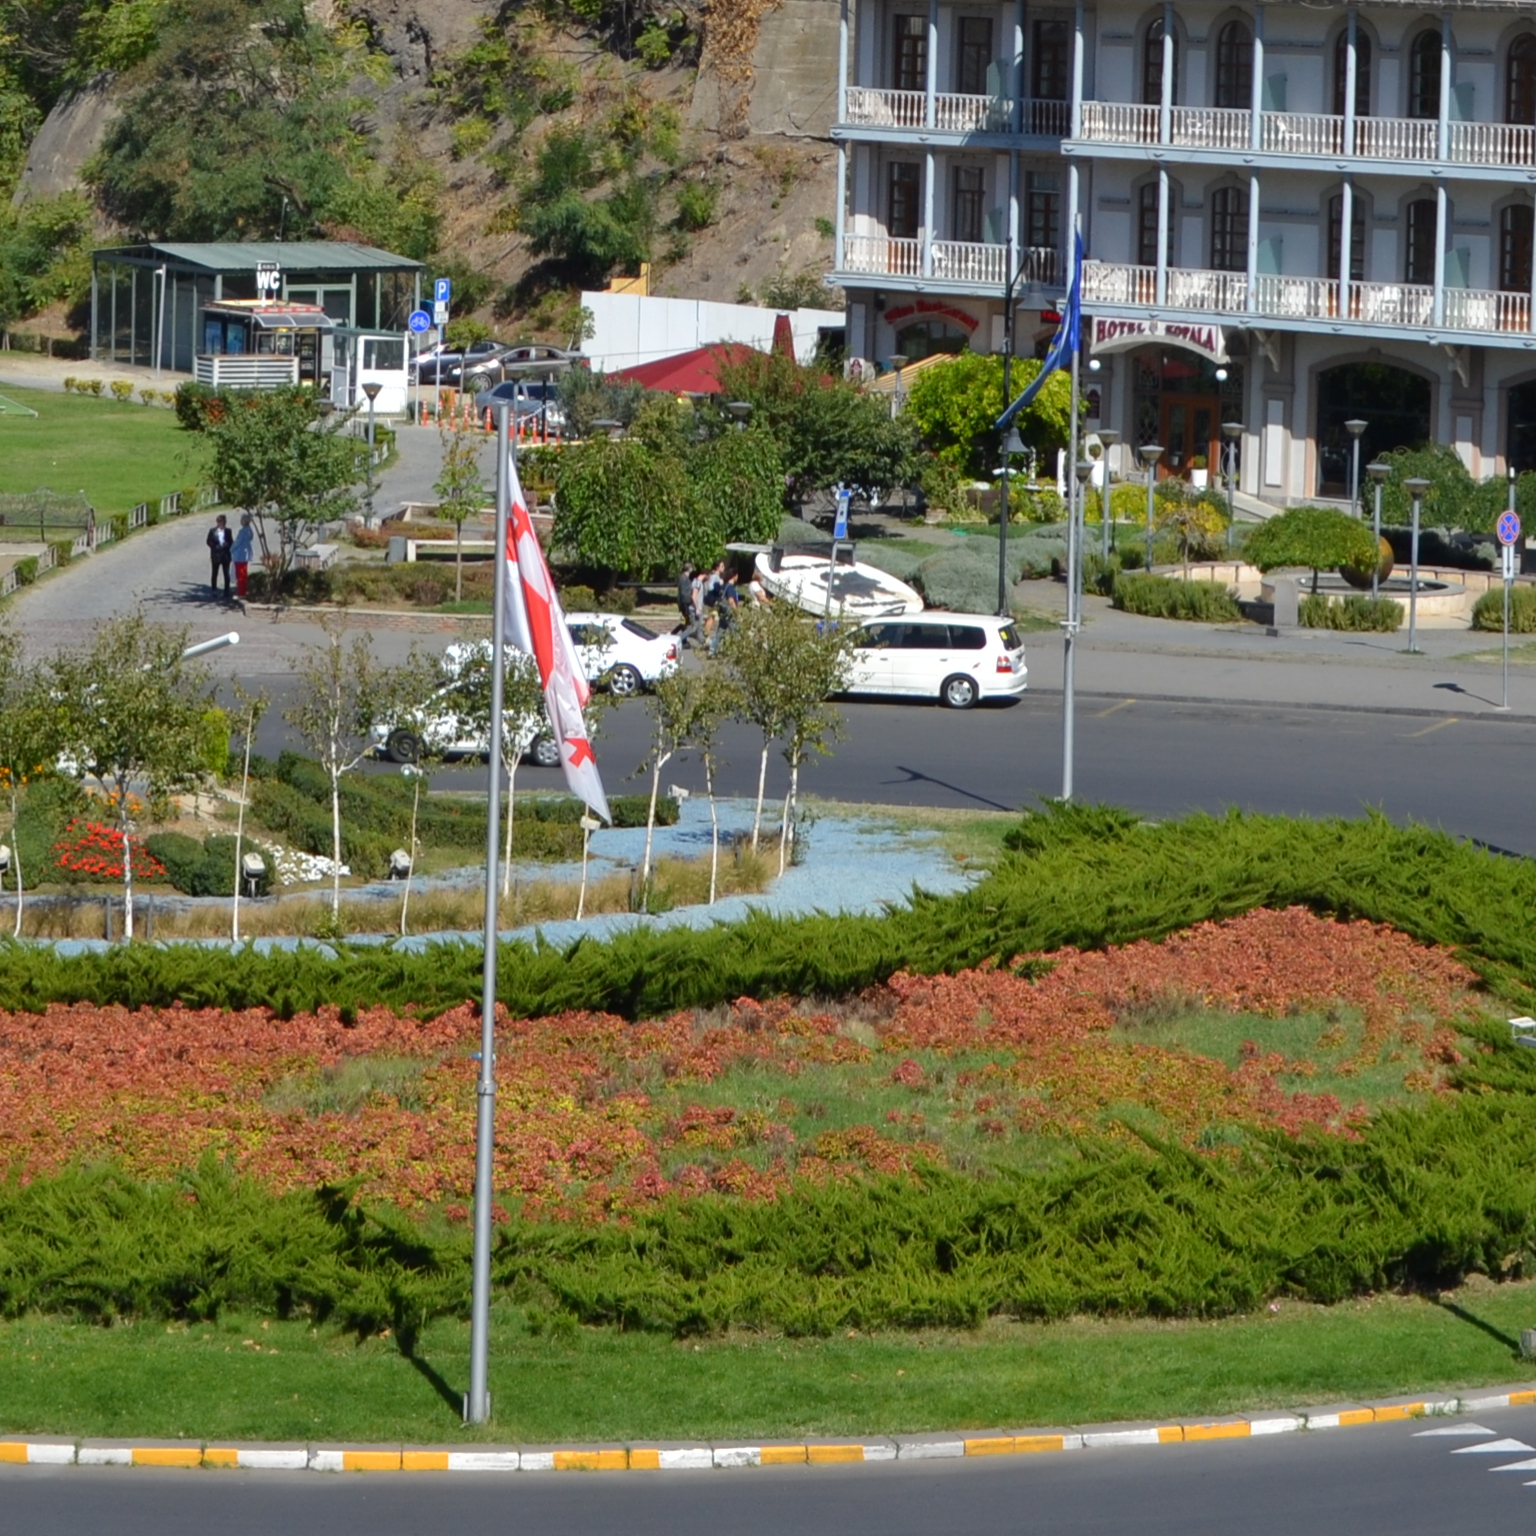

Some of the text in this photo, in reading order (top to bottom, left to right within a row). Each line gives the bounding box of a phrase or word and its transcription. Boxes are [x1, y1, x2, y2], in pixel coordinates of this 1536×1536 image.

[256, 271, 281, 290] WC
[437, 281, 447, 300] P
[1096, 319, 1216, 353] HOTEL KOPALA
